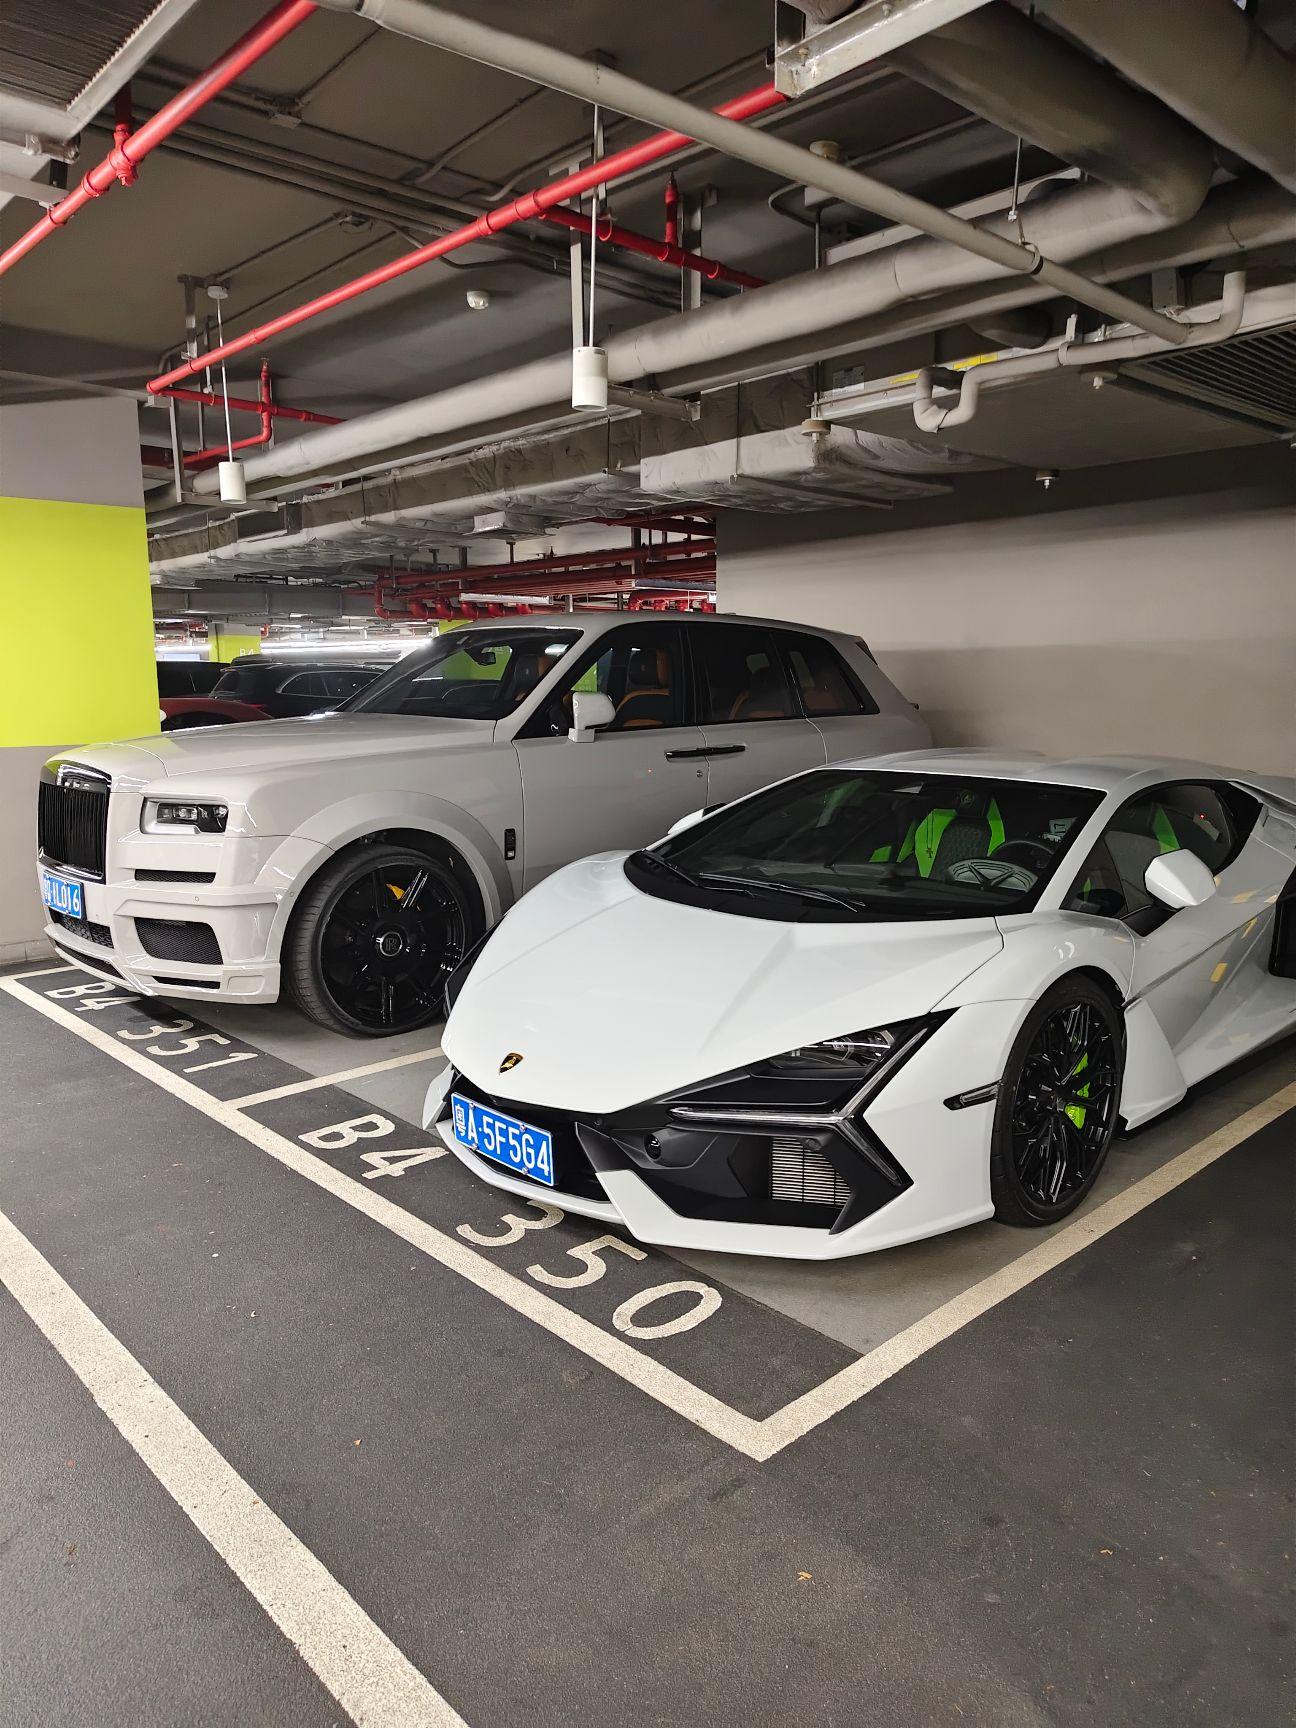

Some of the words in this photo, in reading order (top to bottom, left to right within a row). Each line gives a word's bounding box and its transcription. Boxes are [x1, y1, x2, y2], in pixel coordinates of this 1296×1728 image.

[44, 981, 141, 1012] B4
[116, 1019, 259, 1073] 351
[298, 1113, 451, 1180] B4
[455, 1200, 723, 1340] 350
